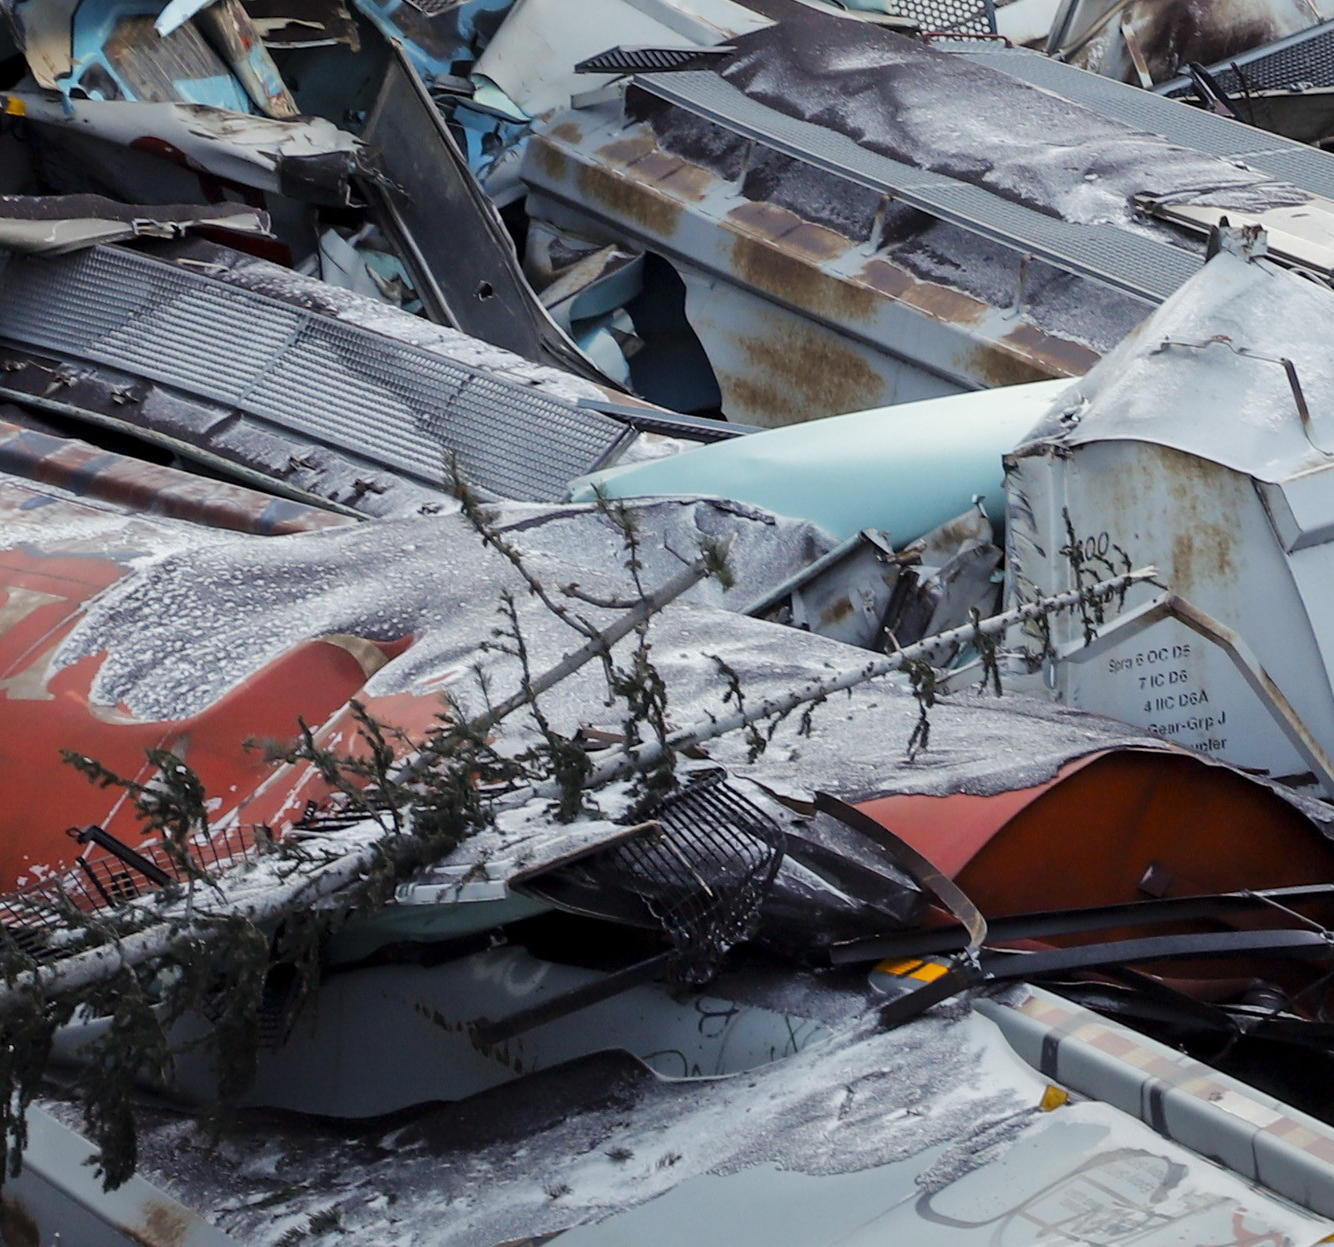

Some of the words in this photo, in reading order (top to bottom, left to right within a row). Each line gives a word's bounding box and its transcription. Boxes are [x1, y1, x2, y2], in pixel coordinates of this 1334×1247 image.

[1136, 653, 1144, 667] 6
[1147, 648, 1169, 664] OC
[1138, 676, 1147, 690] 7
[1150, 673, 1165, 688] IC
[1169, 669, 1189, 685] D6
[1143, 700, 1153, 713] 4
[1178, 689, 1209, 708] D6A
[1217, 710, 1227, 726] J
